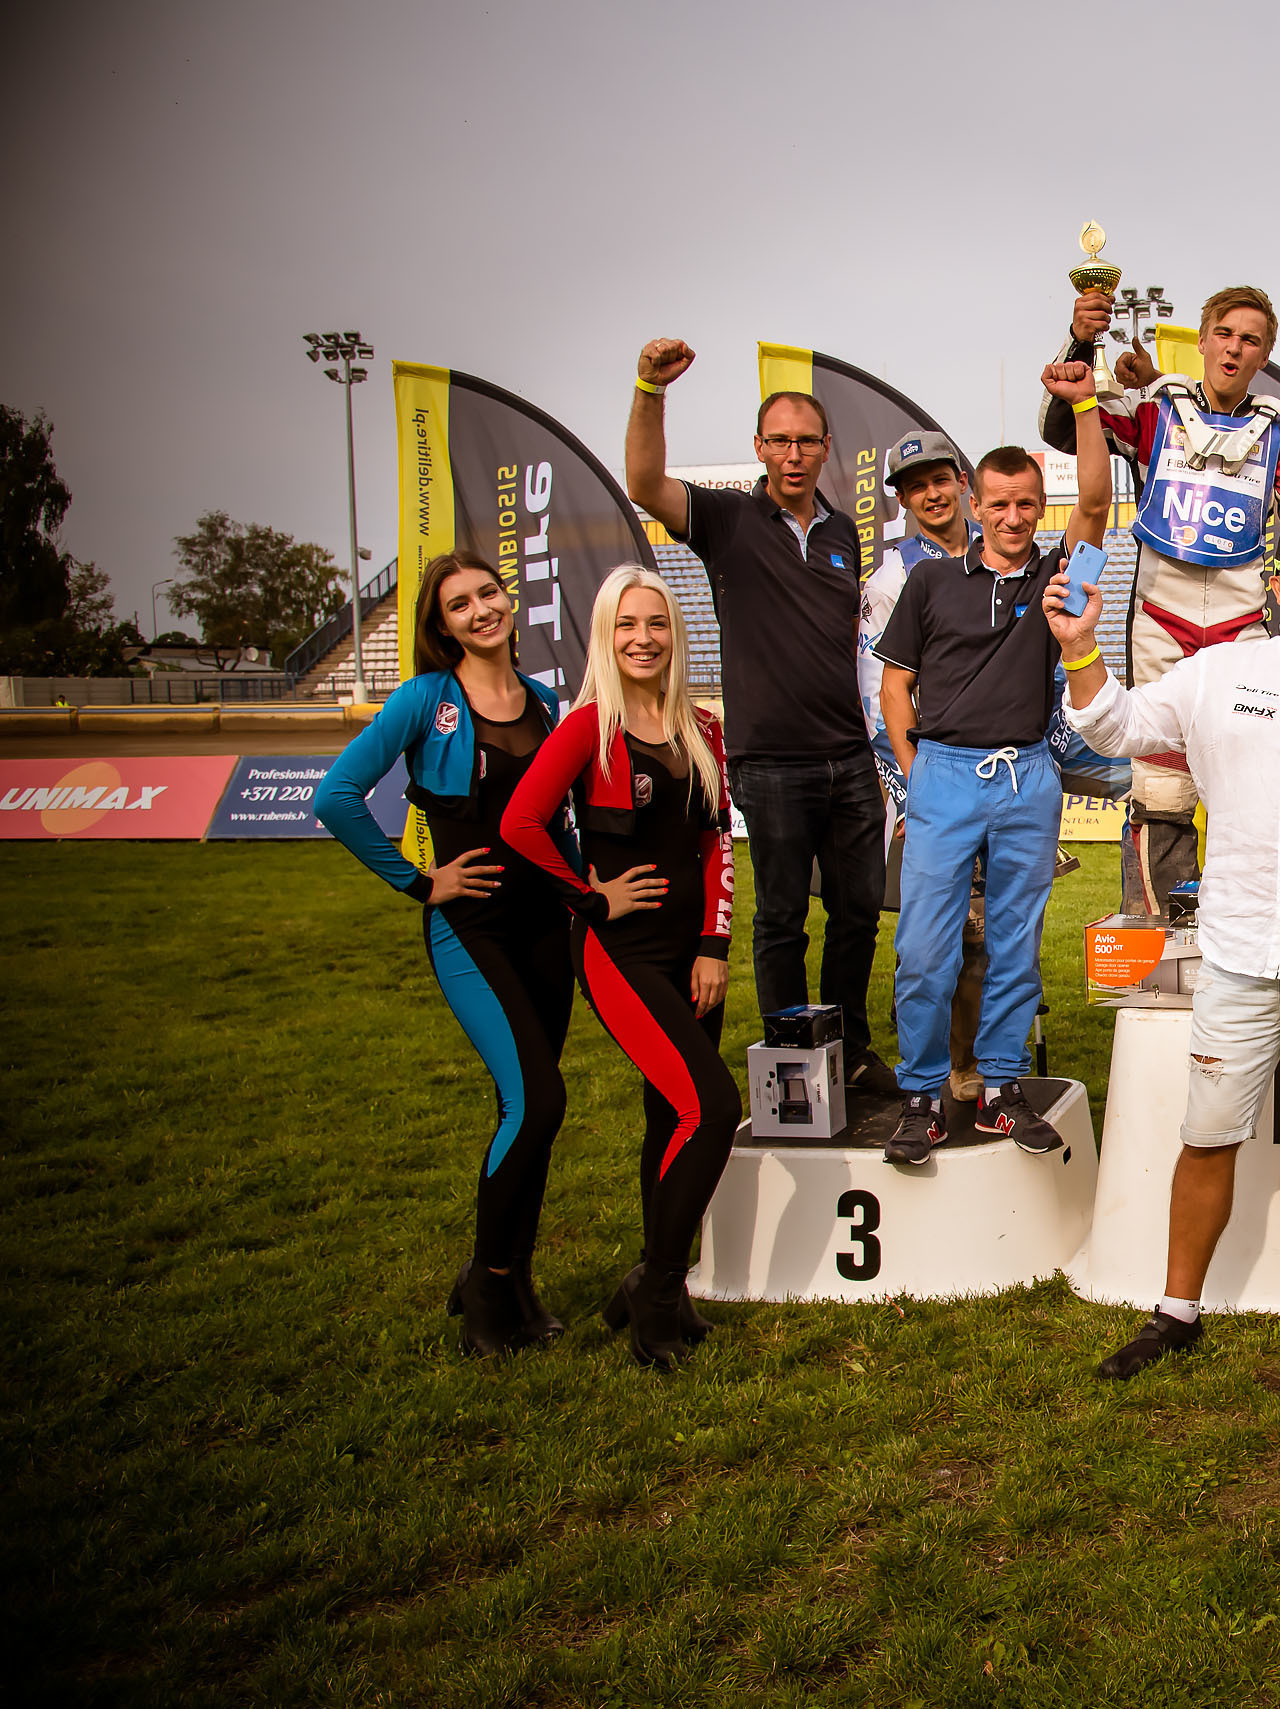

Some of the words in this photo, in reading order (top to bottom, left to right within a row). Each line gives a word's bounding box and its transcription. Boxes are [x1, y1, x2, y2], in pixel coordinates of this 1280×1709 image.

[1162, 486, 1246, 533] Nice
[920, 540, 943, 559] Nice
[0, 786, 169, 810] UNIMAX
[240, 786, 278, 801] +371
[278, 786, 314, 801] 220
[1066, 794, 1119, 811] PER
[230, 811, 308, 821] www.rubenis.lv
[1063, 817, 1100, 825] NTURA
[1094, 934, 1116, 944] Avio
[1094, 945, 1112, 954] 500
[836, 1189, 882, 1282] 3
